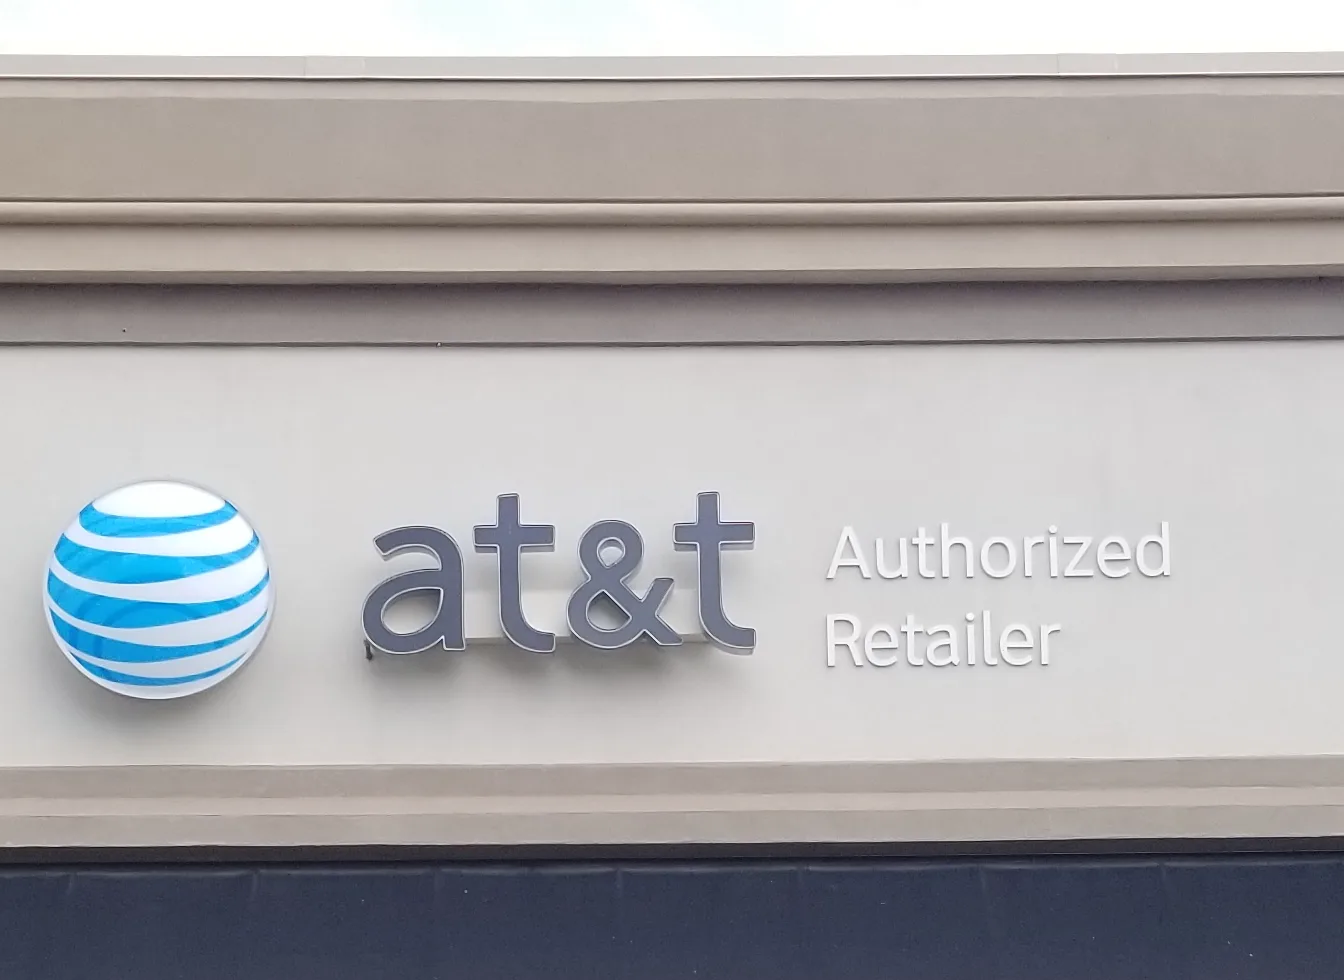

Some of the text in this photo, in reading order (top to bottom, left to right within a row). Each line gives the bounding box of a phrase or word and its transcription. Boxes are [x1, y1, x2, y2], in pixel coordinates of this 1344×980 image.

[361, 490, 757, 655] at&t
[826, 520, 1171, 580] Authorized
[826, 611, 1062, 668] Retailer
